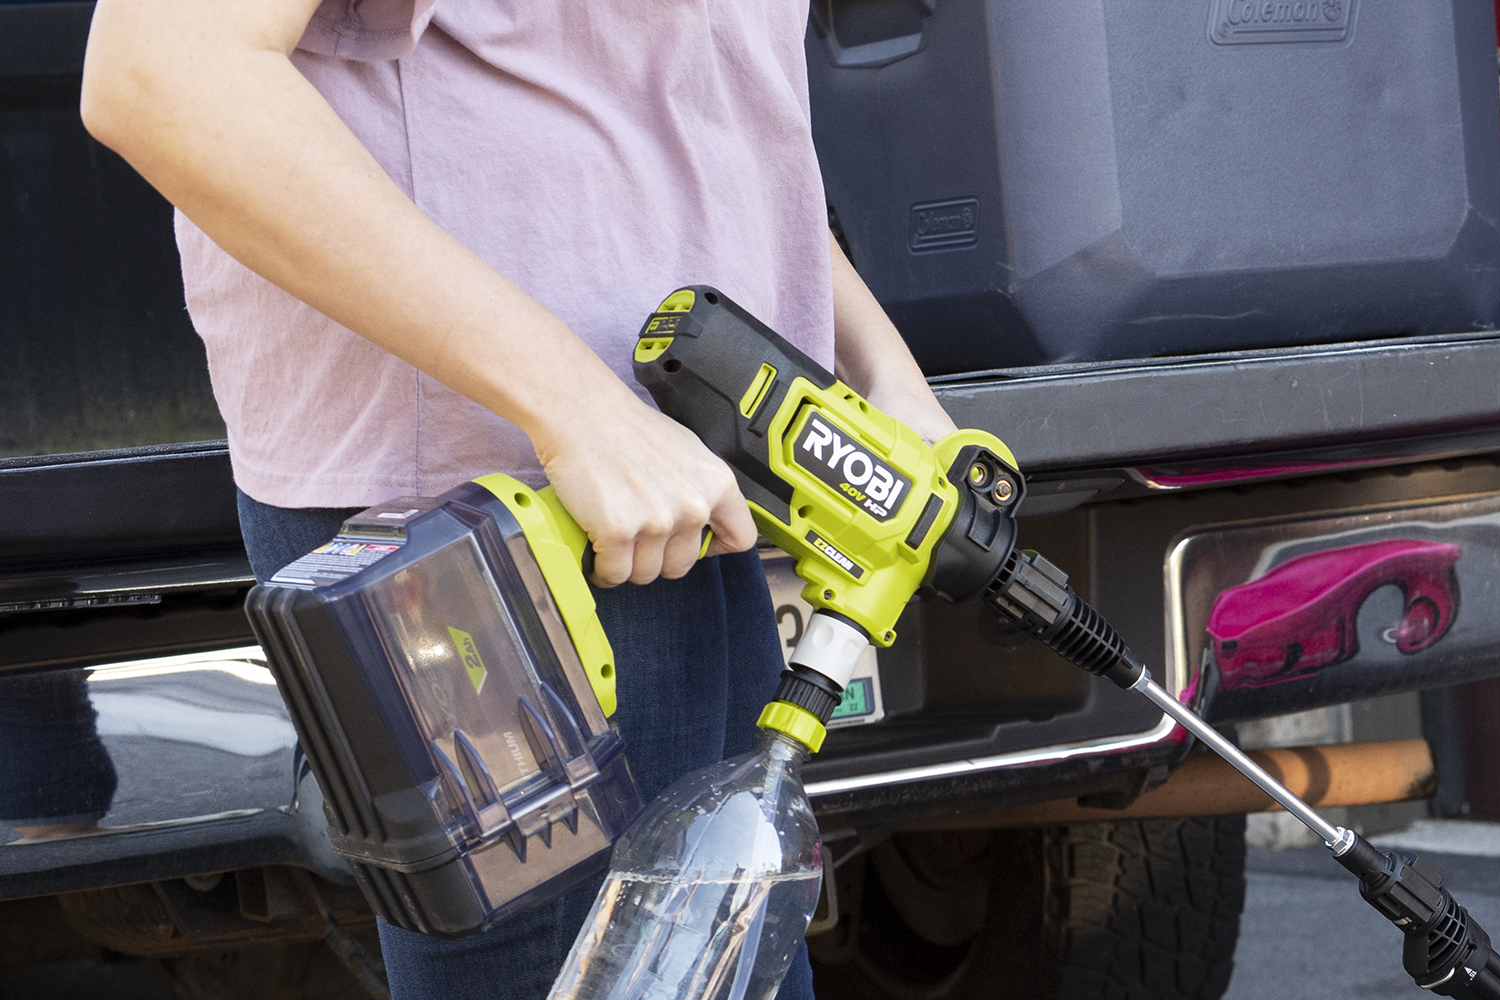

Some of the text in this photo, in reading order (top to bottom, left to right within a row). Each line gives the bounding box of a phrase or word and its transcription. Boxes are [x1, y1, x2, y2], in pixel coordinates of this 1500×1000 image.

[1227, 0, 1318, 25] Coleman
[802, 418, 905, 510] RYOBI
[839, 482, 888, 517] 40V HP
[503, 731, 530, 777] THIUM
